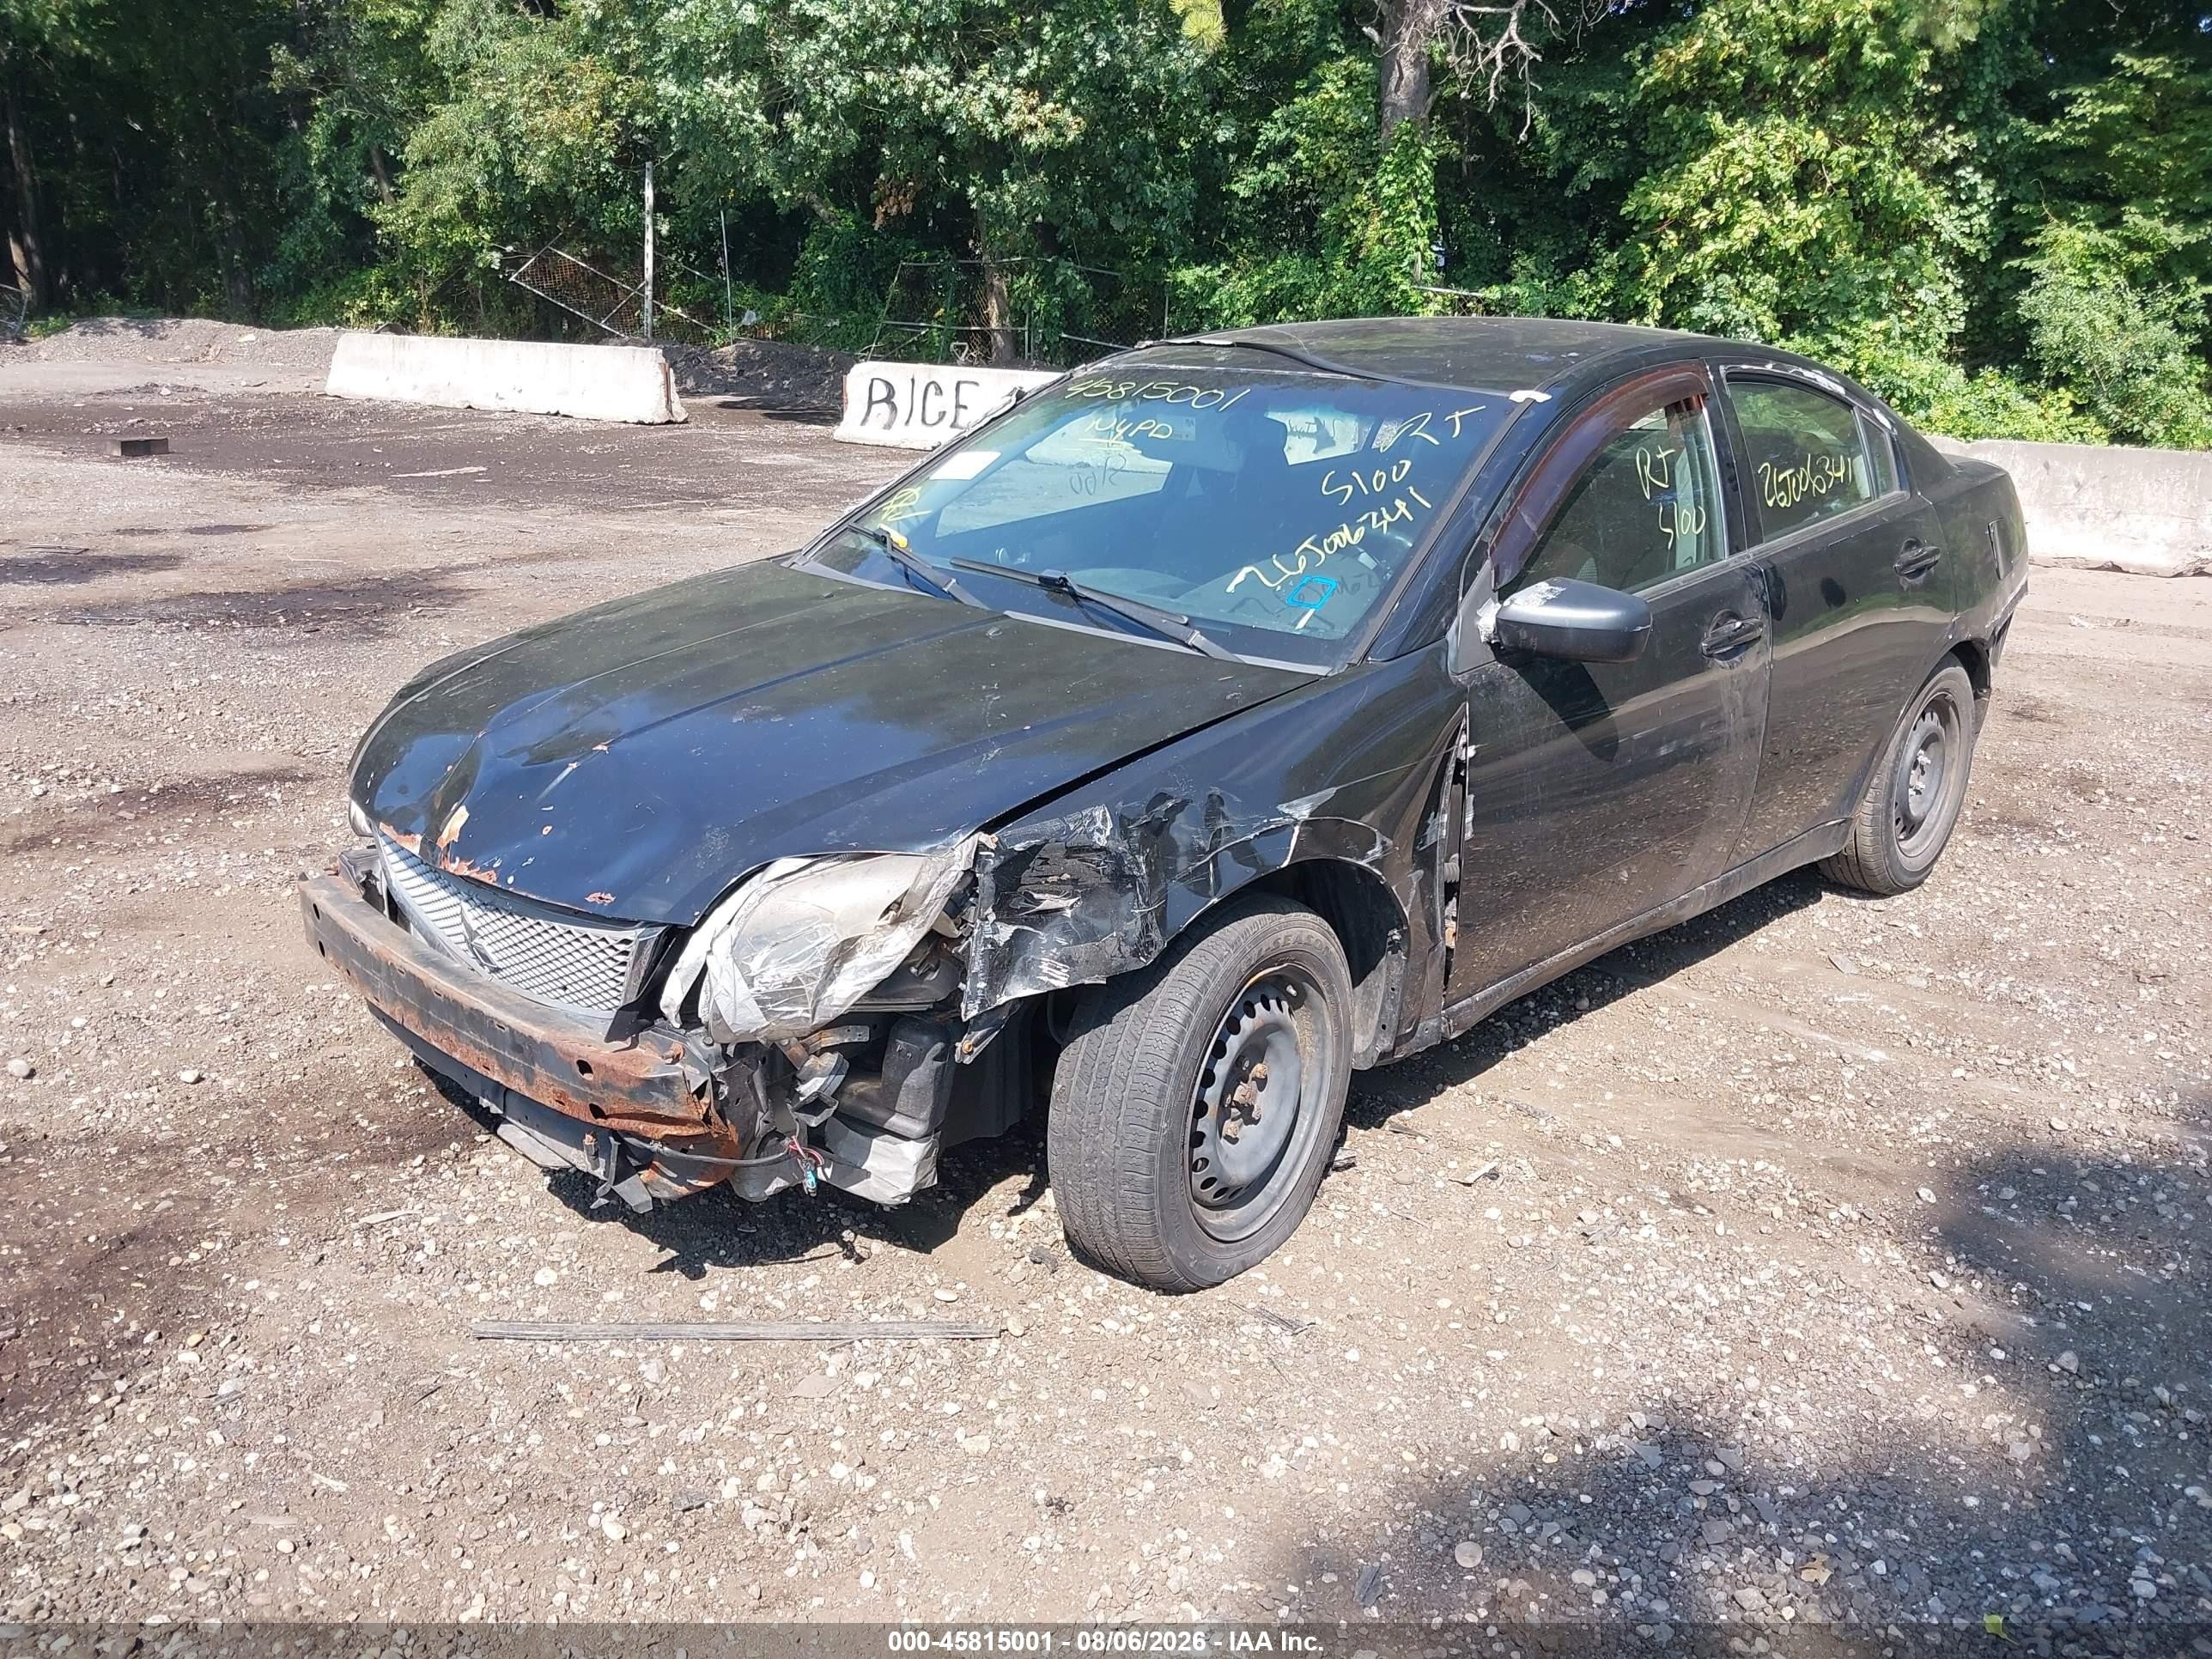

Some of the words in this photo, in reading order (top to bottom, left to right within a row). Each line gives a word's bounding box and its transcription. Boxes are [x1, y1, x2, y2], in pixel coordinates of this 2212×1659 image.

[860, 377, 981, 430] RICE
[1064, 377, 1252, 413] 45815001
[1321, 459, 1413, 506] S100
